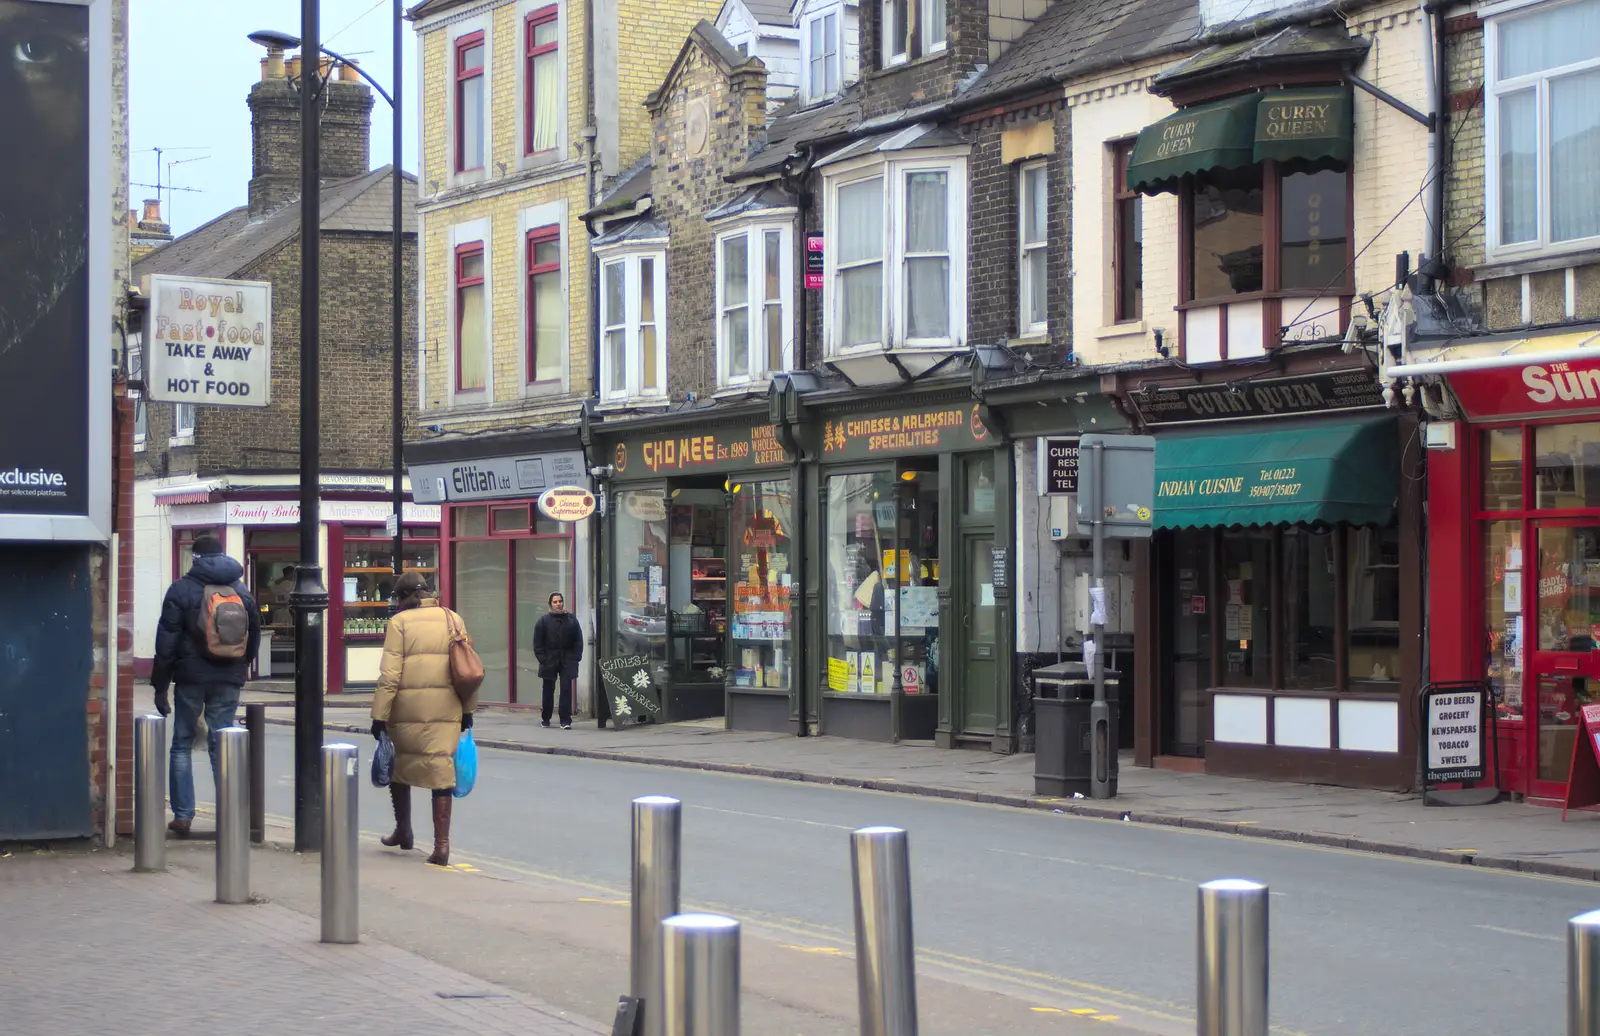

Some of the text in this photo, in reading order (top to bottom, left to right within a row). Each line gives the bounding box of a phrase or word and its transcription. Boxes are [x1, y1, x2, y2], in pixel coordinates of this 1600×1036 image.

[1268, 104, 1330, 120] CURRY
[1163, 120, 1199, 140] CURRY
[1266, 120, 1328, 138] QUEEN
[1156, 136, 1195, 157] QUEEN
[178, 287, 244, 317] Royal
[156, 315, 265, 346] Fast food
[165, 342, 252, 361] TAKE AWAY
[204, 362, 214, 376] &
[1550, 362, 1570, 372] THE
[167, 378, 250, 396] HOT FOOD
[1521, 365, 1600, 403] Sun
[1187, 382, 1325, 415] CURRY QUEEN
[848, 409, 963, 436] CHINESE & MALAYSIAN
[751, 424, 777, 440] IMPORT
[868, 429, 939, 451] SPECIALITIES
[643, 439, 675, 473] CHO
[678, 435, 715, 469] MEE
[731, 441, 749, 458] 1989
[755, 449, 785, 465] & RETAIL
[1050, 447, 1079, 457] CURR
[322, 475, 386, 484] DEVONSHIRE ROAD
[452, 465, 497, 493] Elitian
[498, 475, 511, 489] Ltd
[1273, 467, 1296, 480] 01223
[1056, 480, 1074, 489] TEL
[1158, 477, 1244, 497] INDIAN CUISINE
[329, 504, 364, 517] Andrew
[559, 497, 580, 507] Chinese
[230, 504, 268, 522] Family
[552, 505, 588, 518] Supermarket
[601, 653, 649, 671] CHINESE
[602, 670, 661, 714] SUPERMARKET
[614, 695, 632, 716] 美
[1435, 696, 1475, 706] COLD BEERS
[1439, 710, 1470, 720] GROCERY
[1431, 725, 1477, 735] NEWSPAPERS
[1438, 740, 1469, 750] TOBACCO
[1440, 755, 1467, 765] SWEETS
[1427, 769, 1481, 781] theguardian
